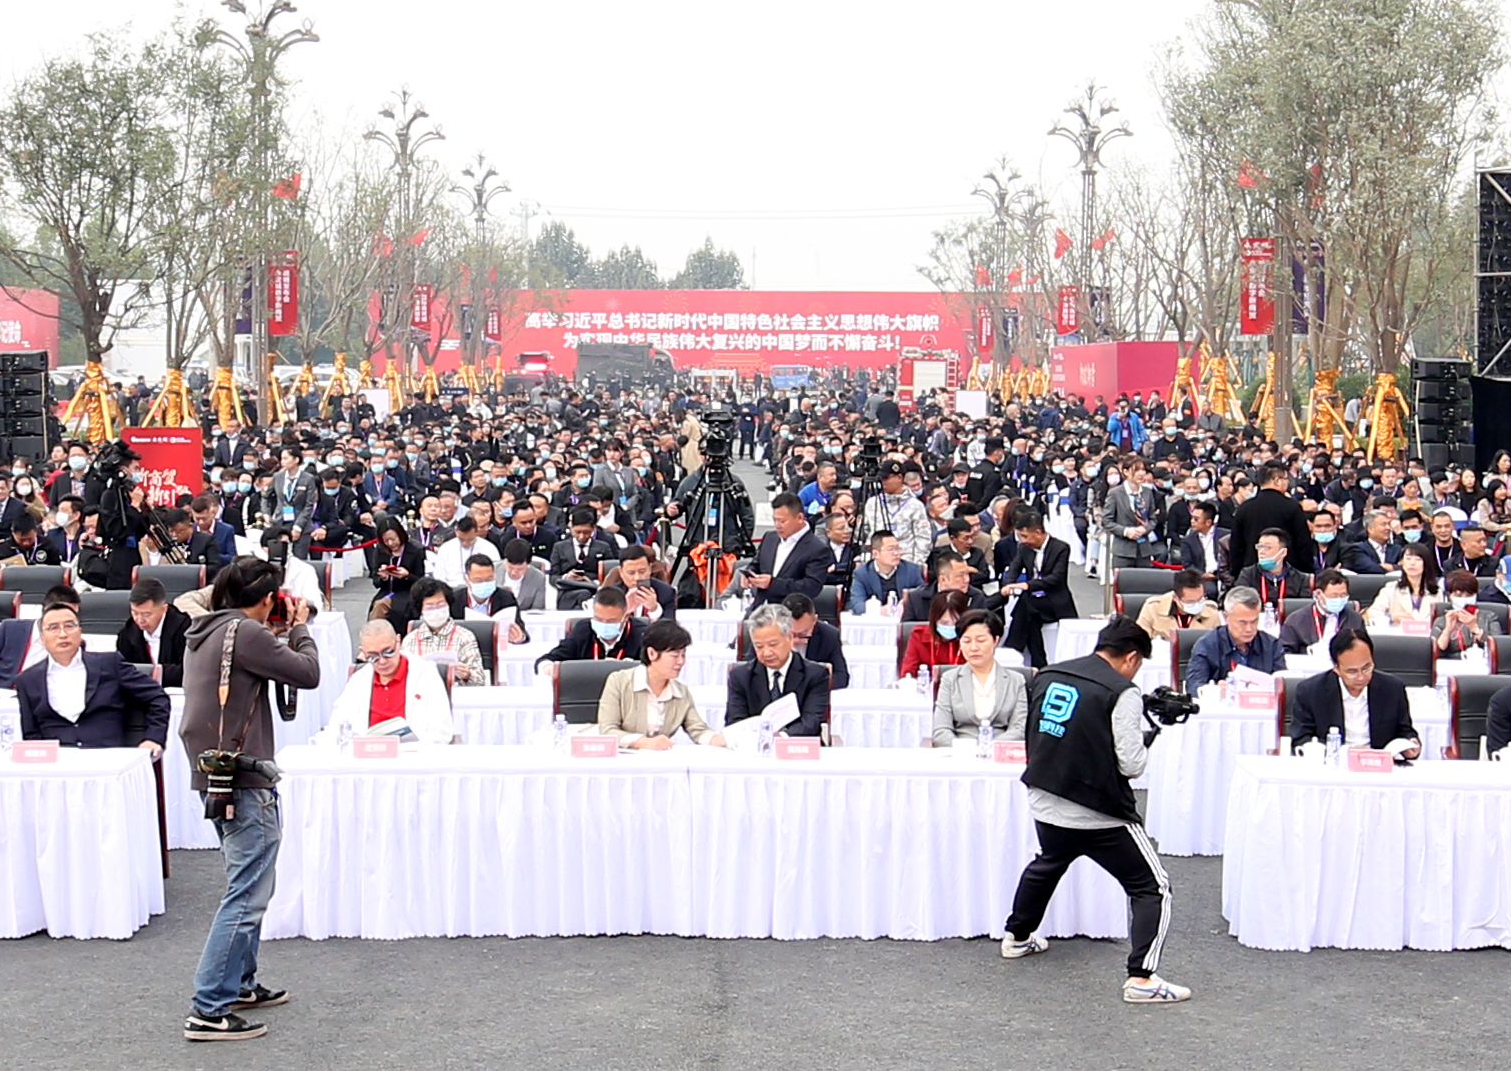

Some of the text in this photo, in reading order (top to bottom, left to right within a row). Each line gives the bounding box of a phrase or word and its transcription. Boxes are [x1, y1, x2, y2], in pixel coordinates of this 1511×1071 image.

[525, 312, 940, 332] 高举习近平总书记新时代中国特色社会主义思想伟大旗帜
